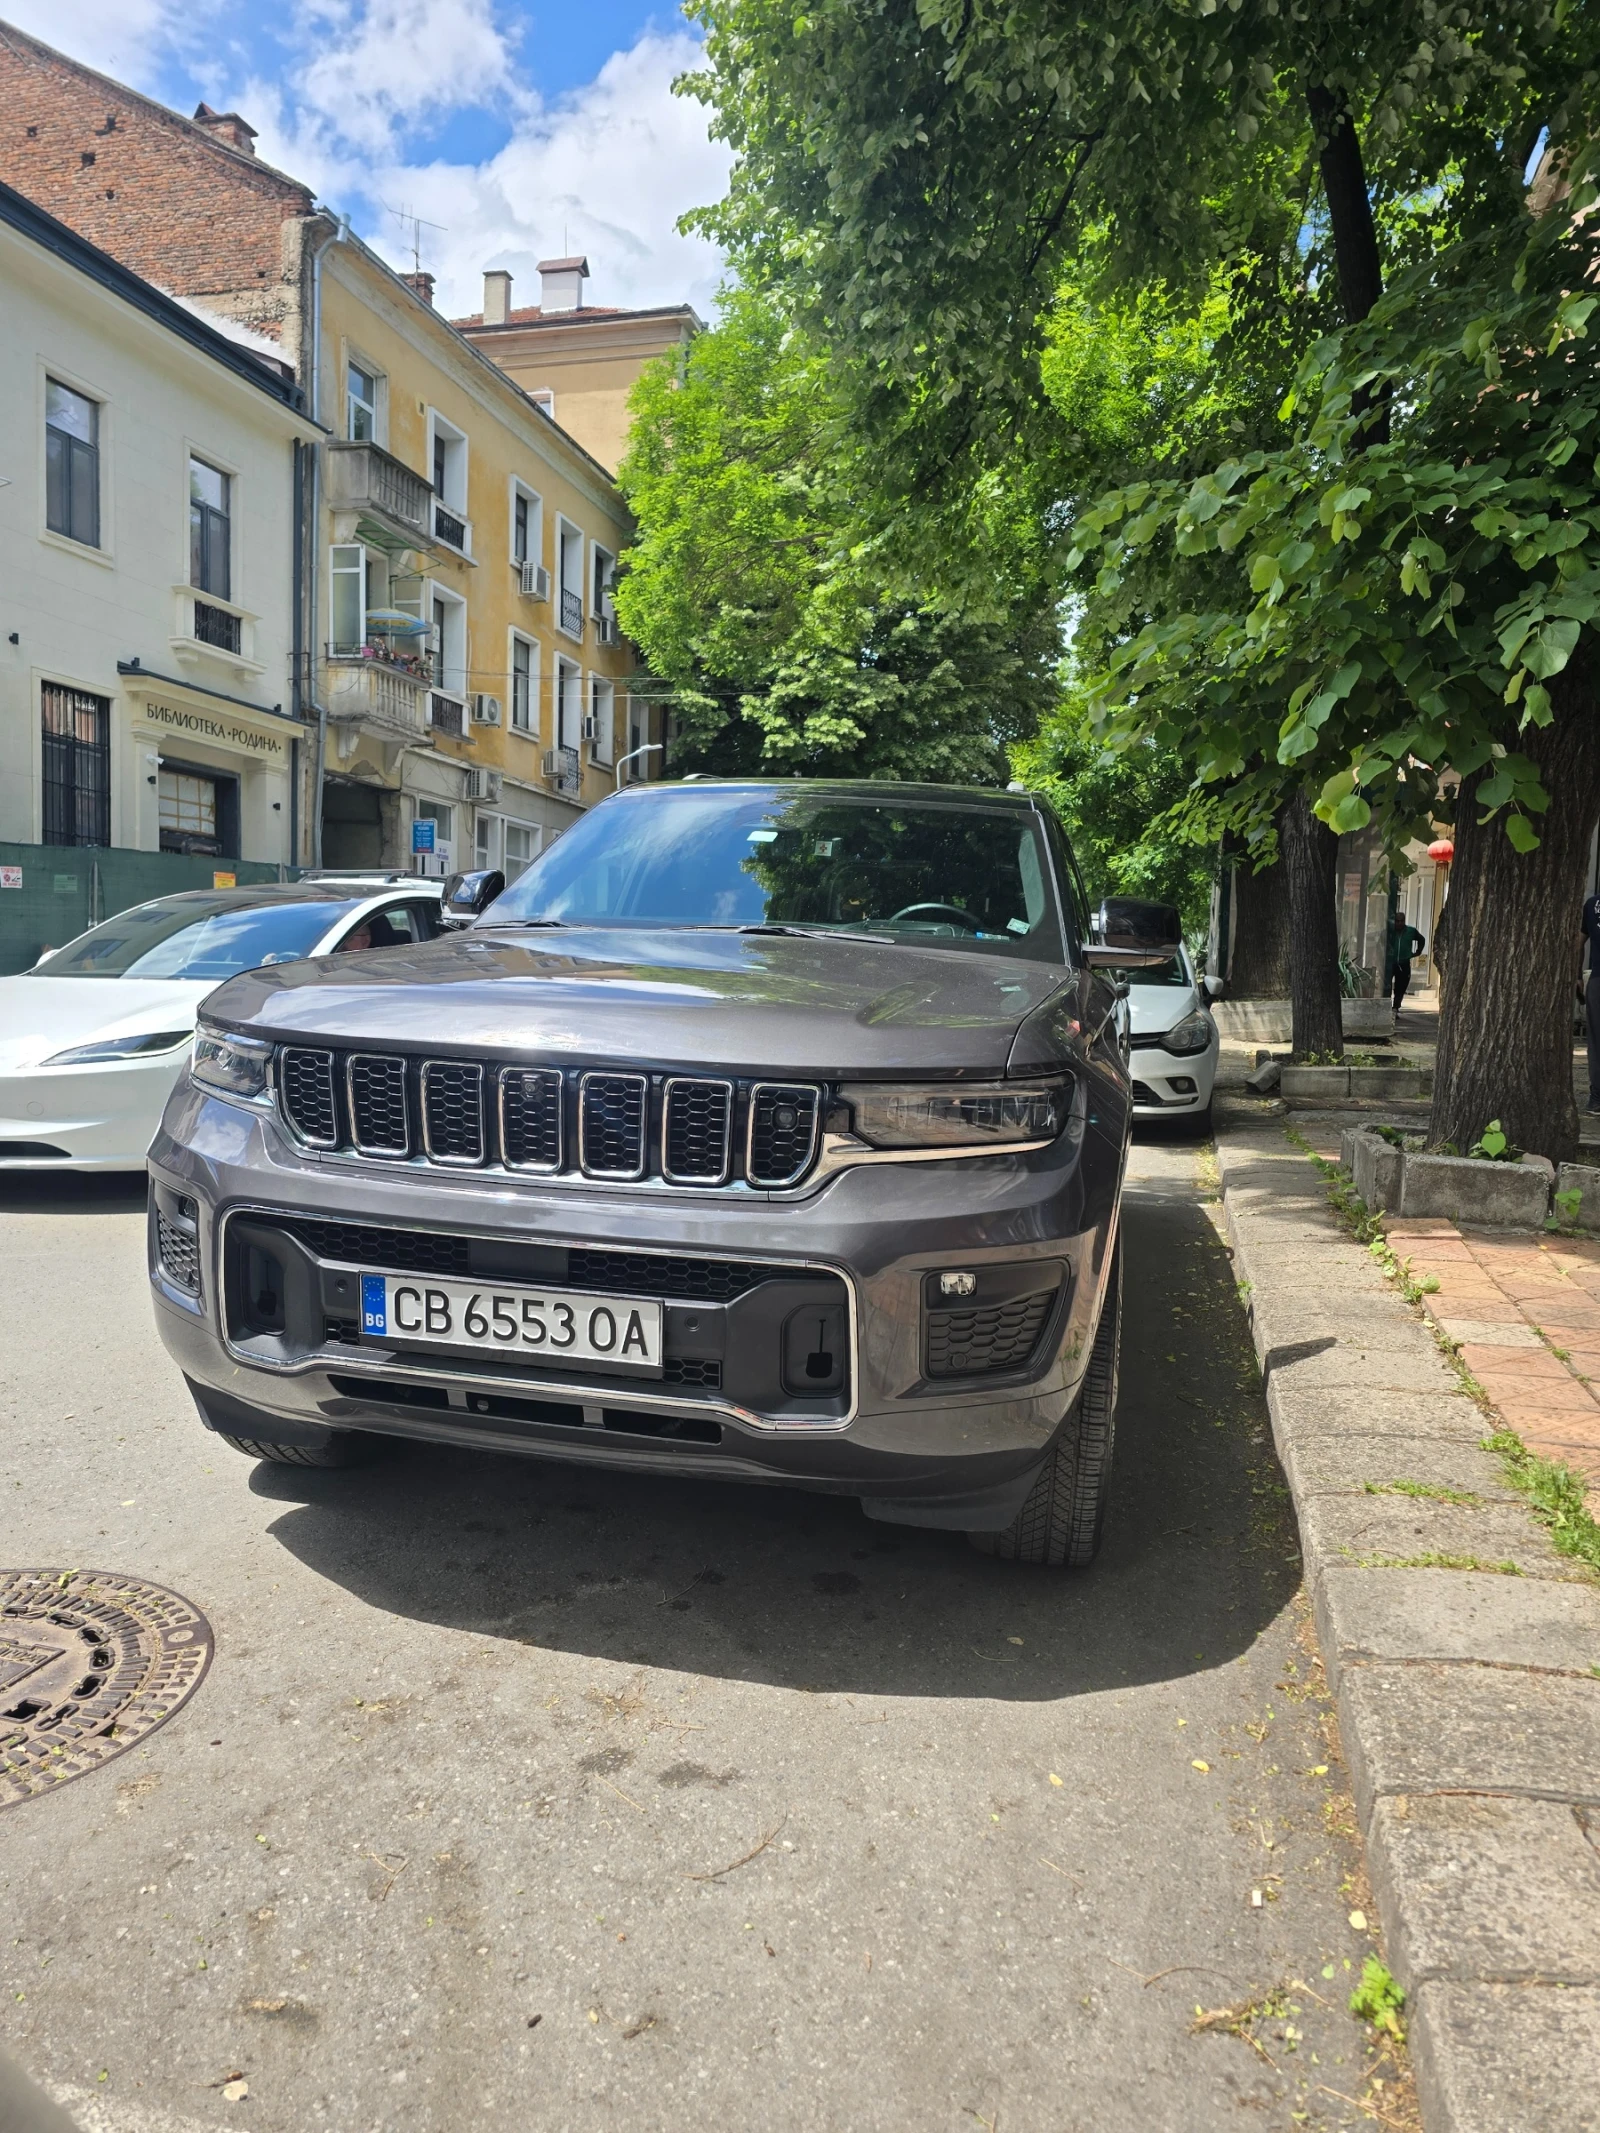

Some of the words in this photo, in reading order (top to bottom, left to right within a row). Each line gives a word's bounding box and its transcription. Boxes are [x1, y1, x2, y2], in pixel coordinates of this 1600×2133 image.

[146, 703, 225, 739] БИБЛИОТЕКА
[365, 1313, 385, 1328] BG
[394, 1286, 451, 1335] CB
[464, 1293, 576, 1348] 6553
